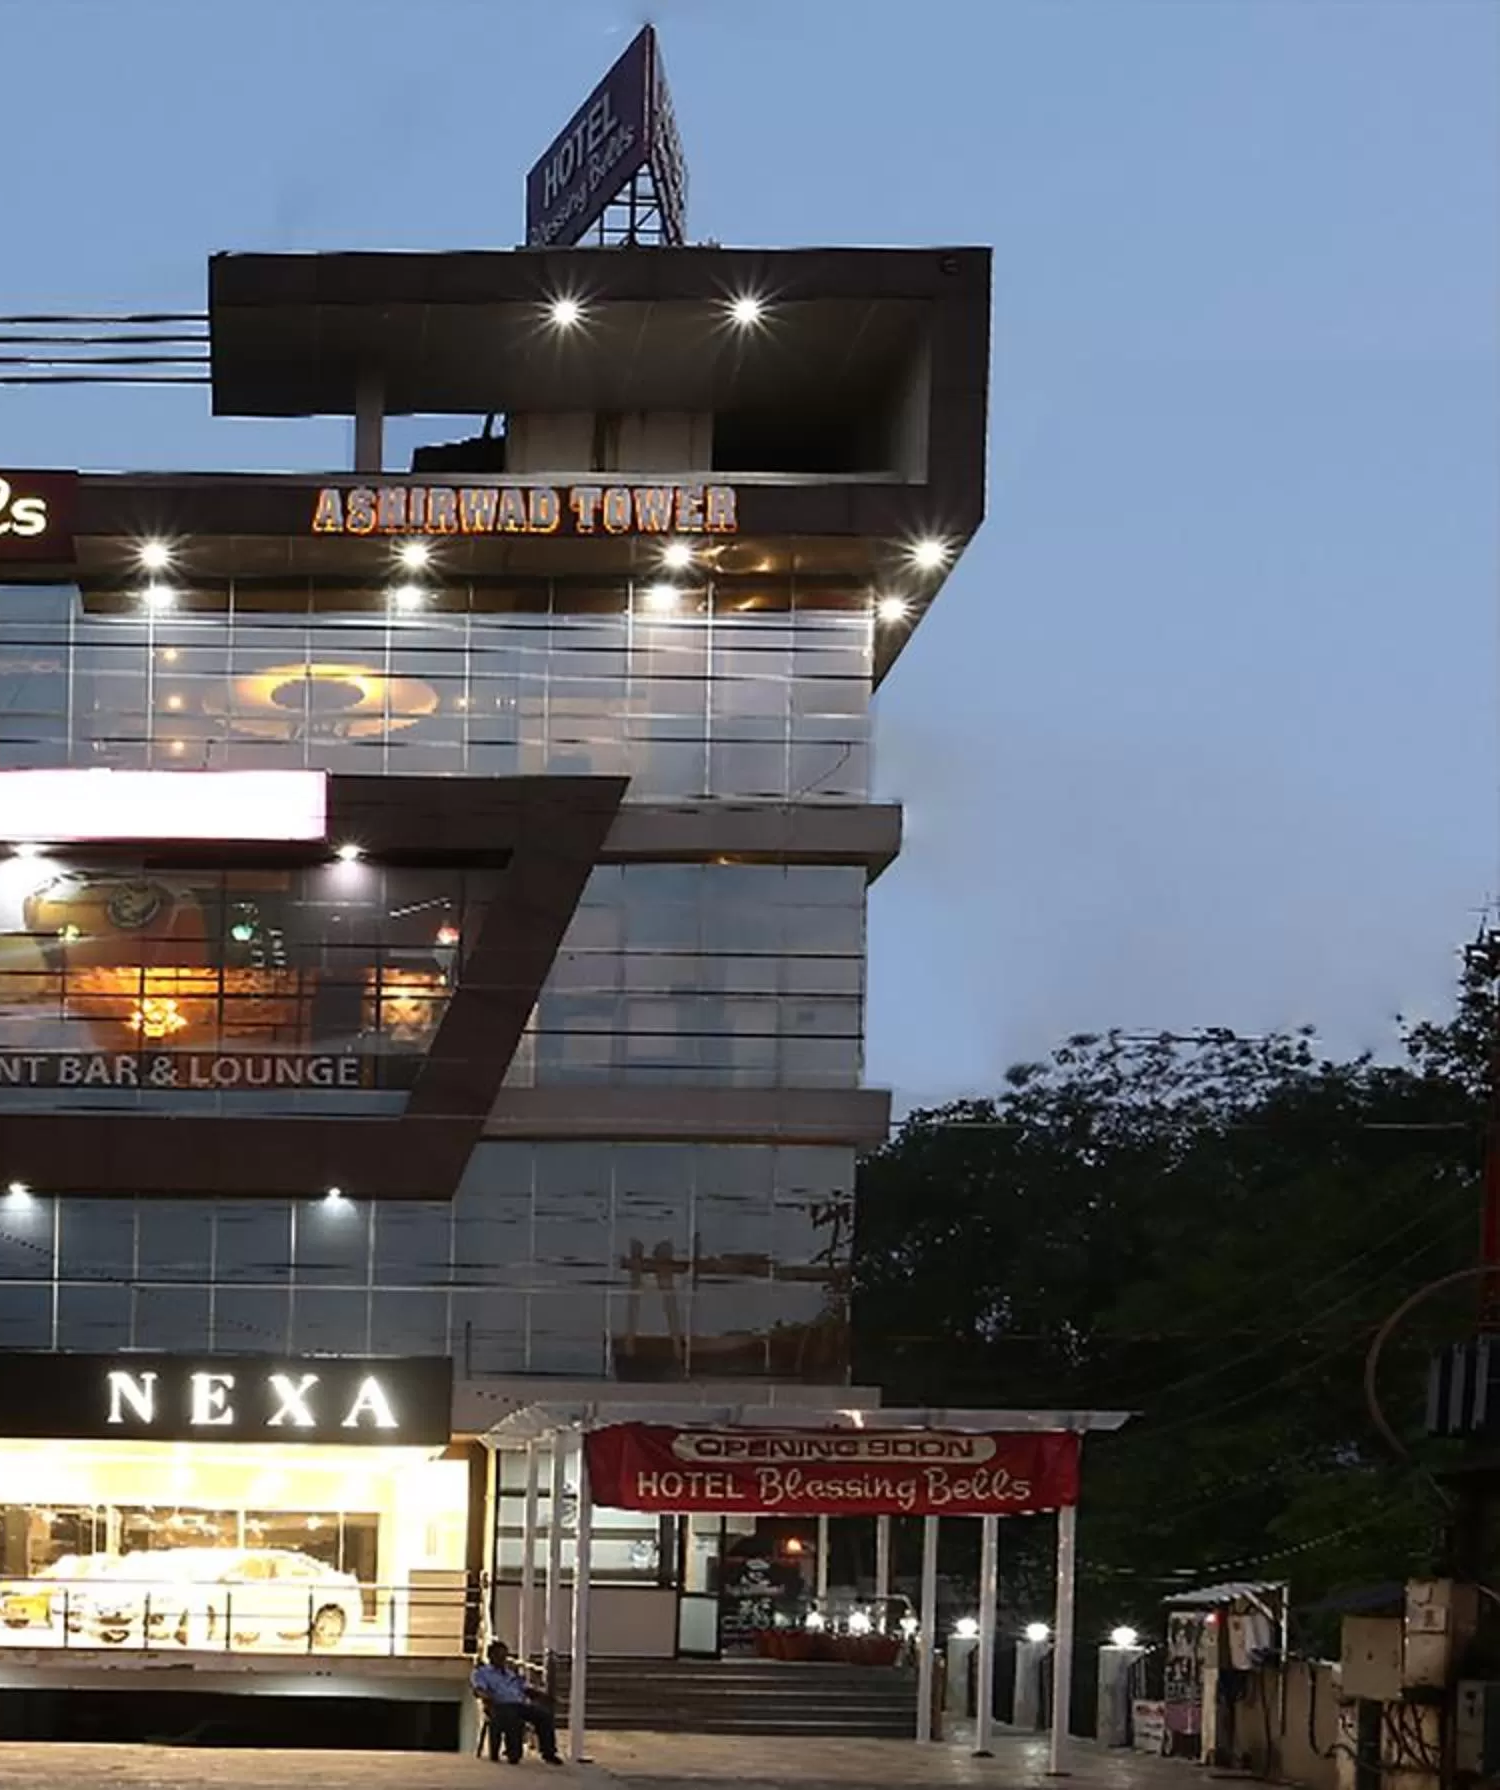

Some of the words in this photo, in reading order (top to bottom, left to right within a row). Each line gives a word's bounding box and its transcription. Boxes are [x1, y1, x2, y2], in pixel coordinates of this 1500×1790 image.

[543, 90, 618, 209] HOTEL
[312, 485, 560, 535] ASHIRWAD
[571, 485, 739, 535] TOWER
[58, 1055, 139, 1085] BAR
[149, 1057, 179, 1086] &
[189, 1057, 360, 1086] LOUNGE
[106, 1371, 399, 1427] NEXA
[694, 1437, 858, 1458] OPENING
[867, 1438, 975, 1458] SOON
[637, 1470, 745, 1499] HOTEL
[755, 1466, 917, 1512] Blessing
[924, 1466, 1032, 1506] Bells
